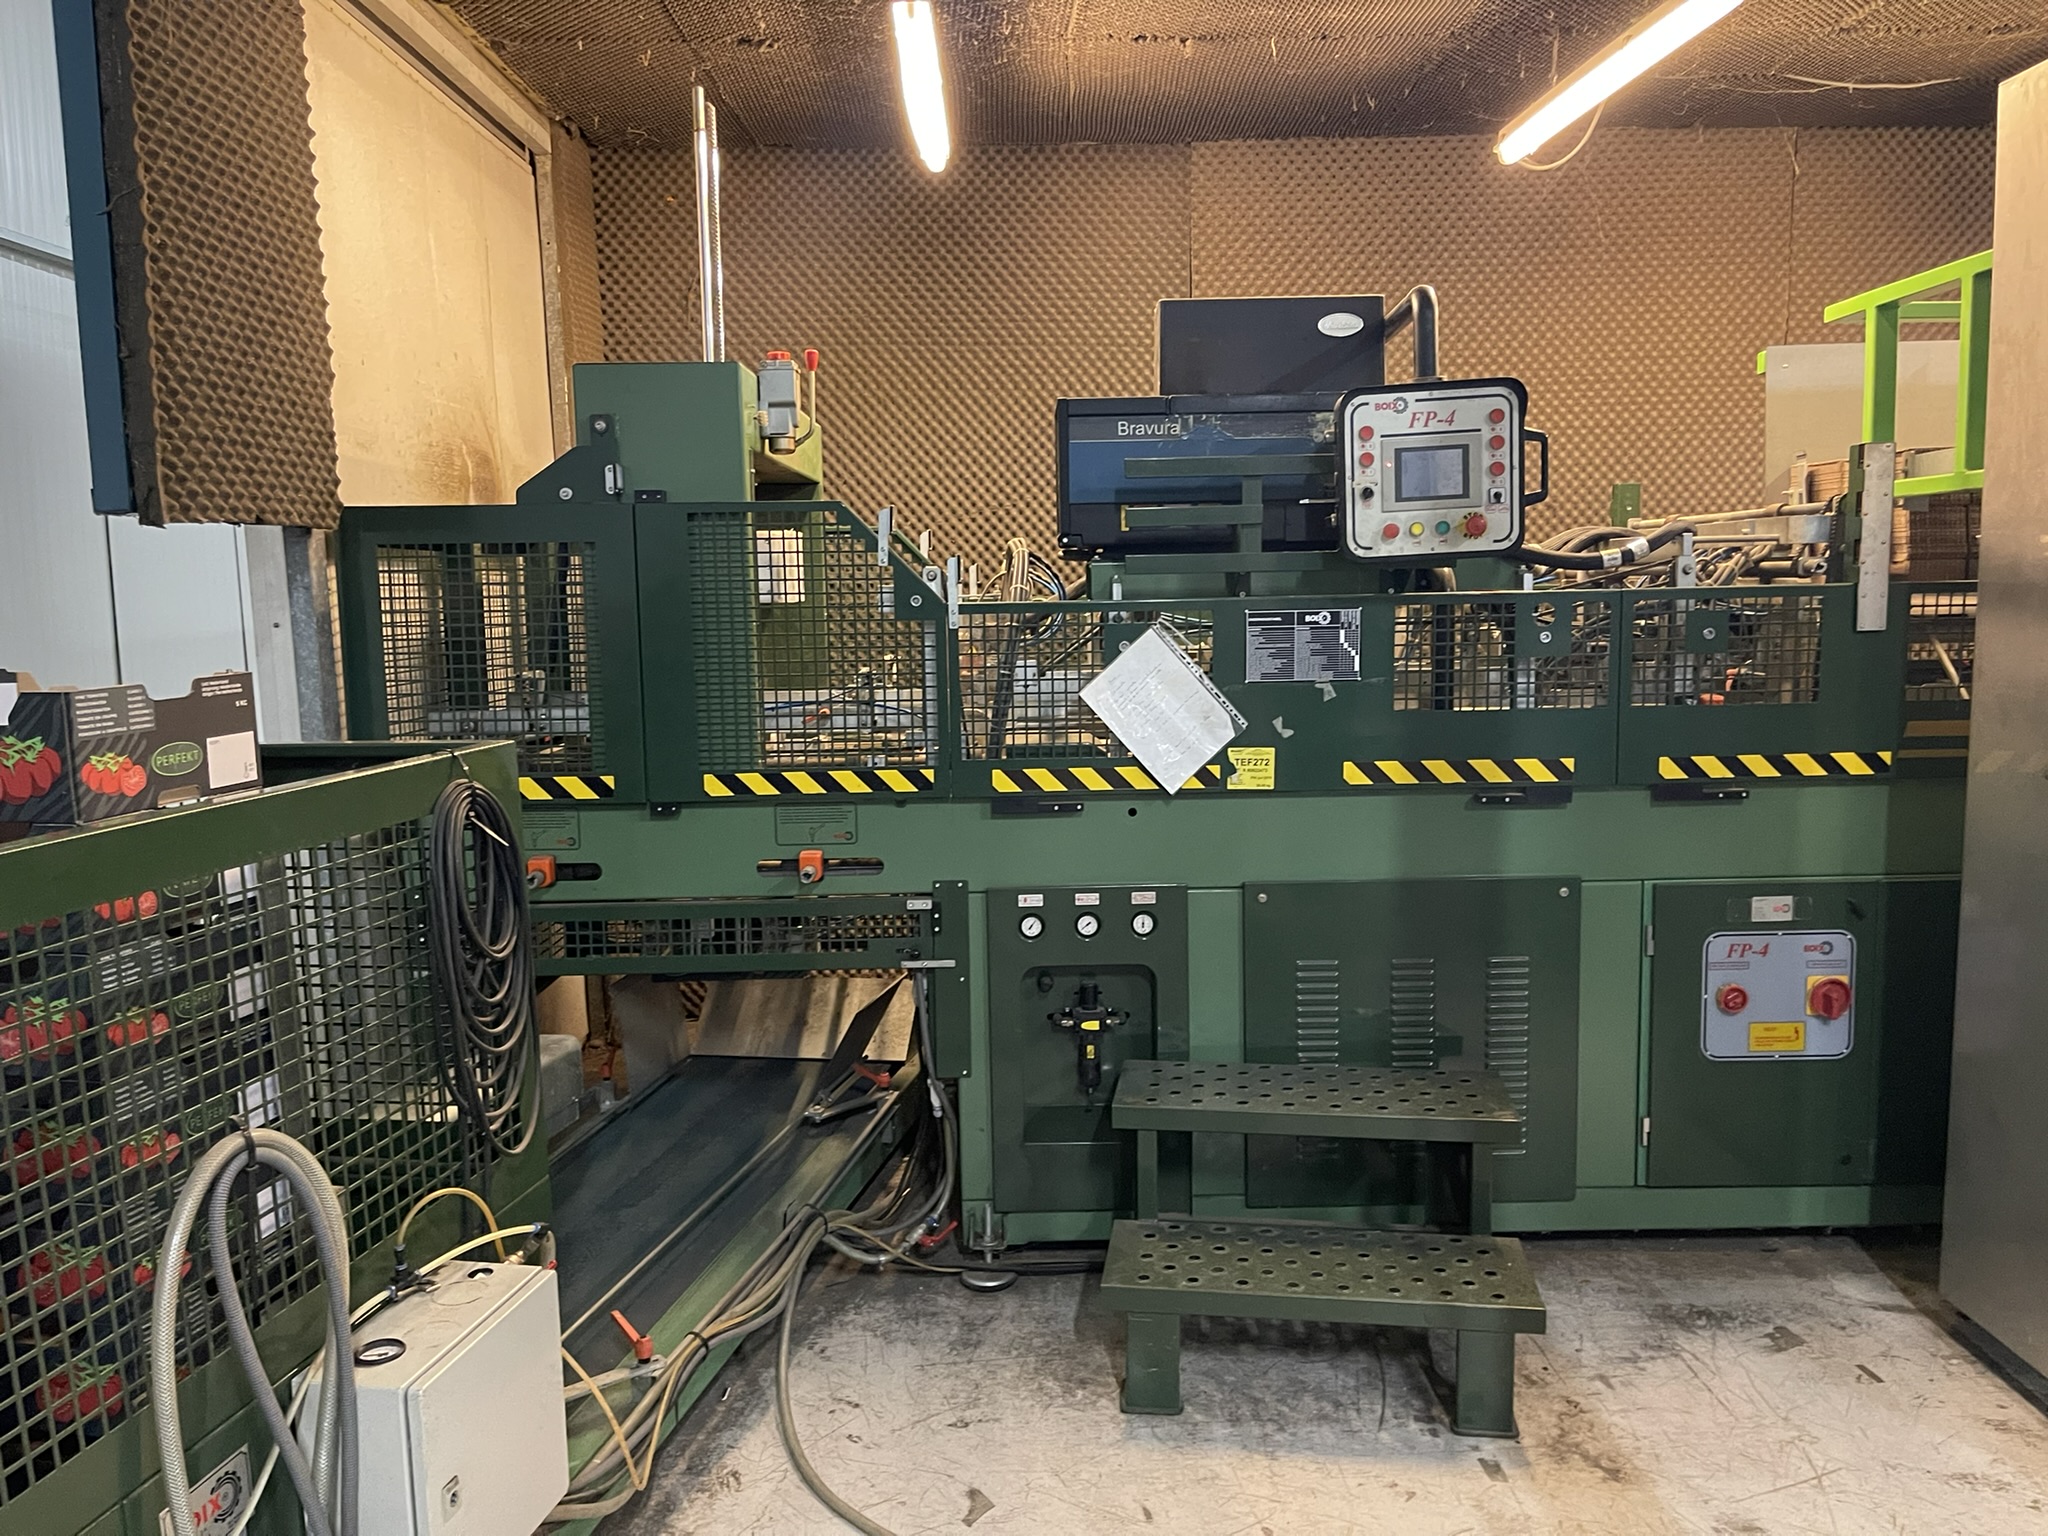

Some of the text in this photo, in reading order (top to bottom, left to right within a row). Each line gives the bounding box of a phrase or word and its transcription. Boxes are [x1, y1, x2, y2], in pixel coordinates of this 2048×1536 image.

[1374, 400, 1398, 411] BOIX
[1408, 409, 1457, 429] FP-4
[1117, 421, 1181, 436] Bravura
[156, 750, 199, 767] PERFEKT
[1234, 758, 1270, 767] TEF272
[1727, 942, 1770, 958] FP-4
